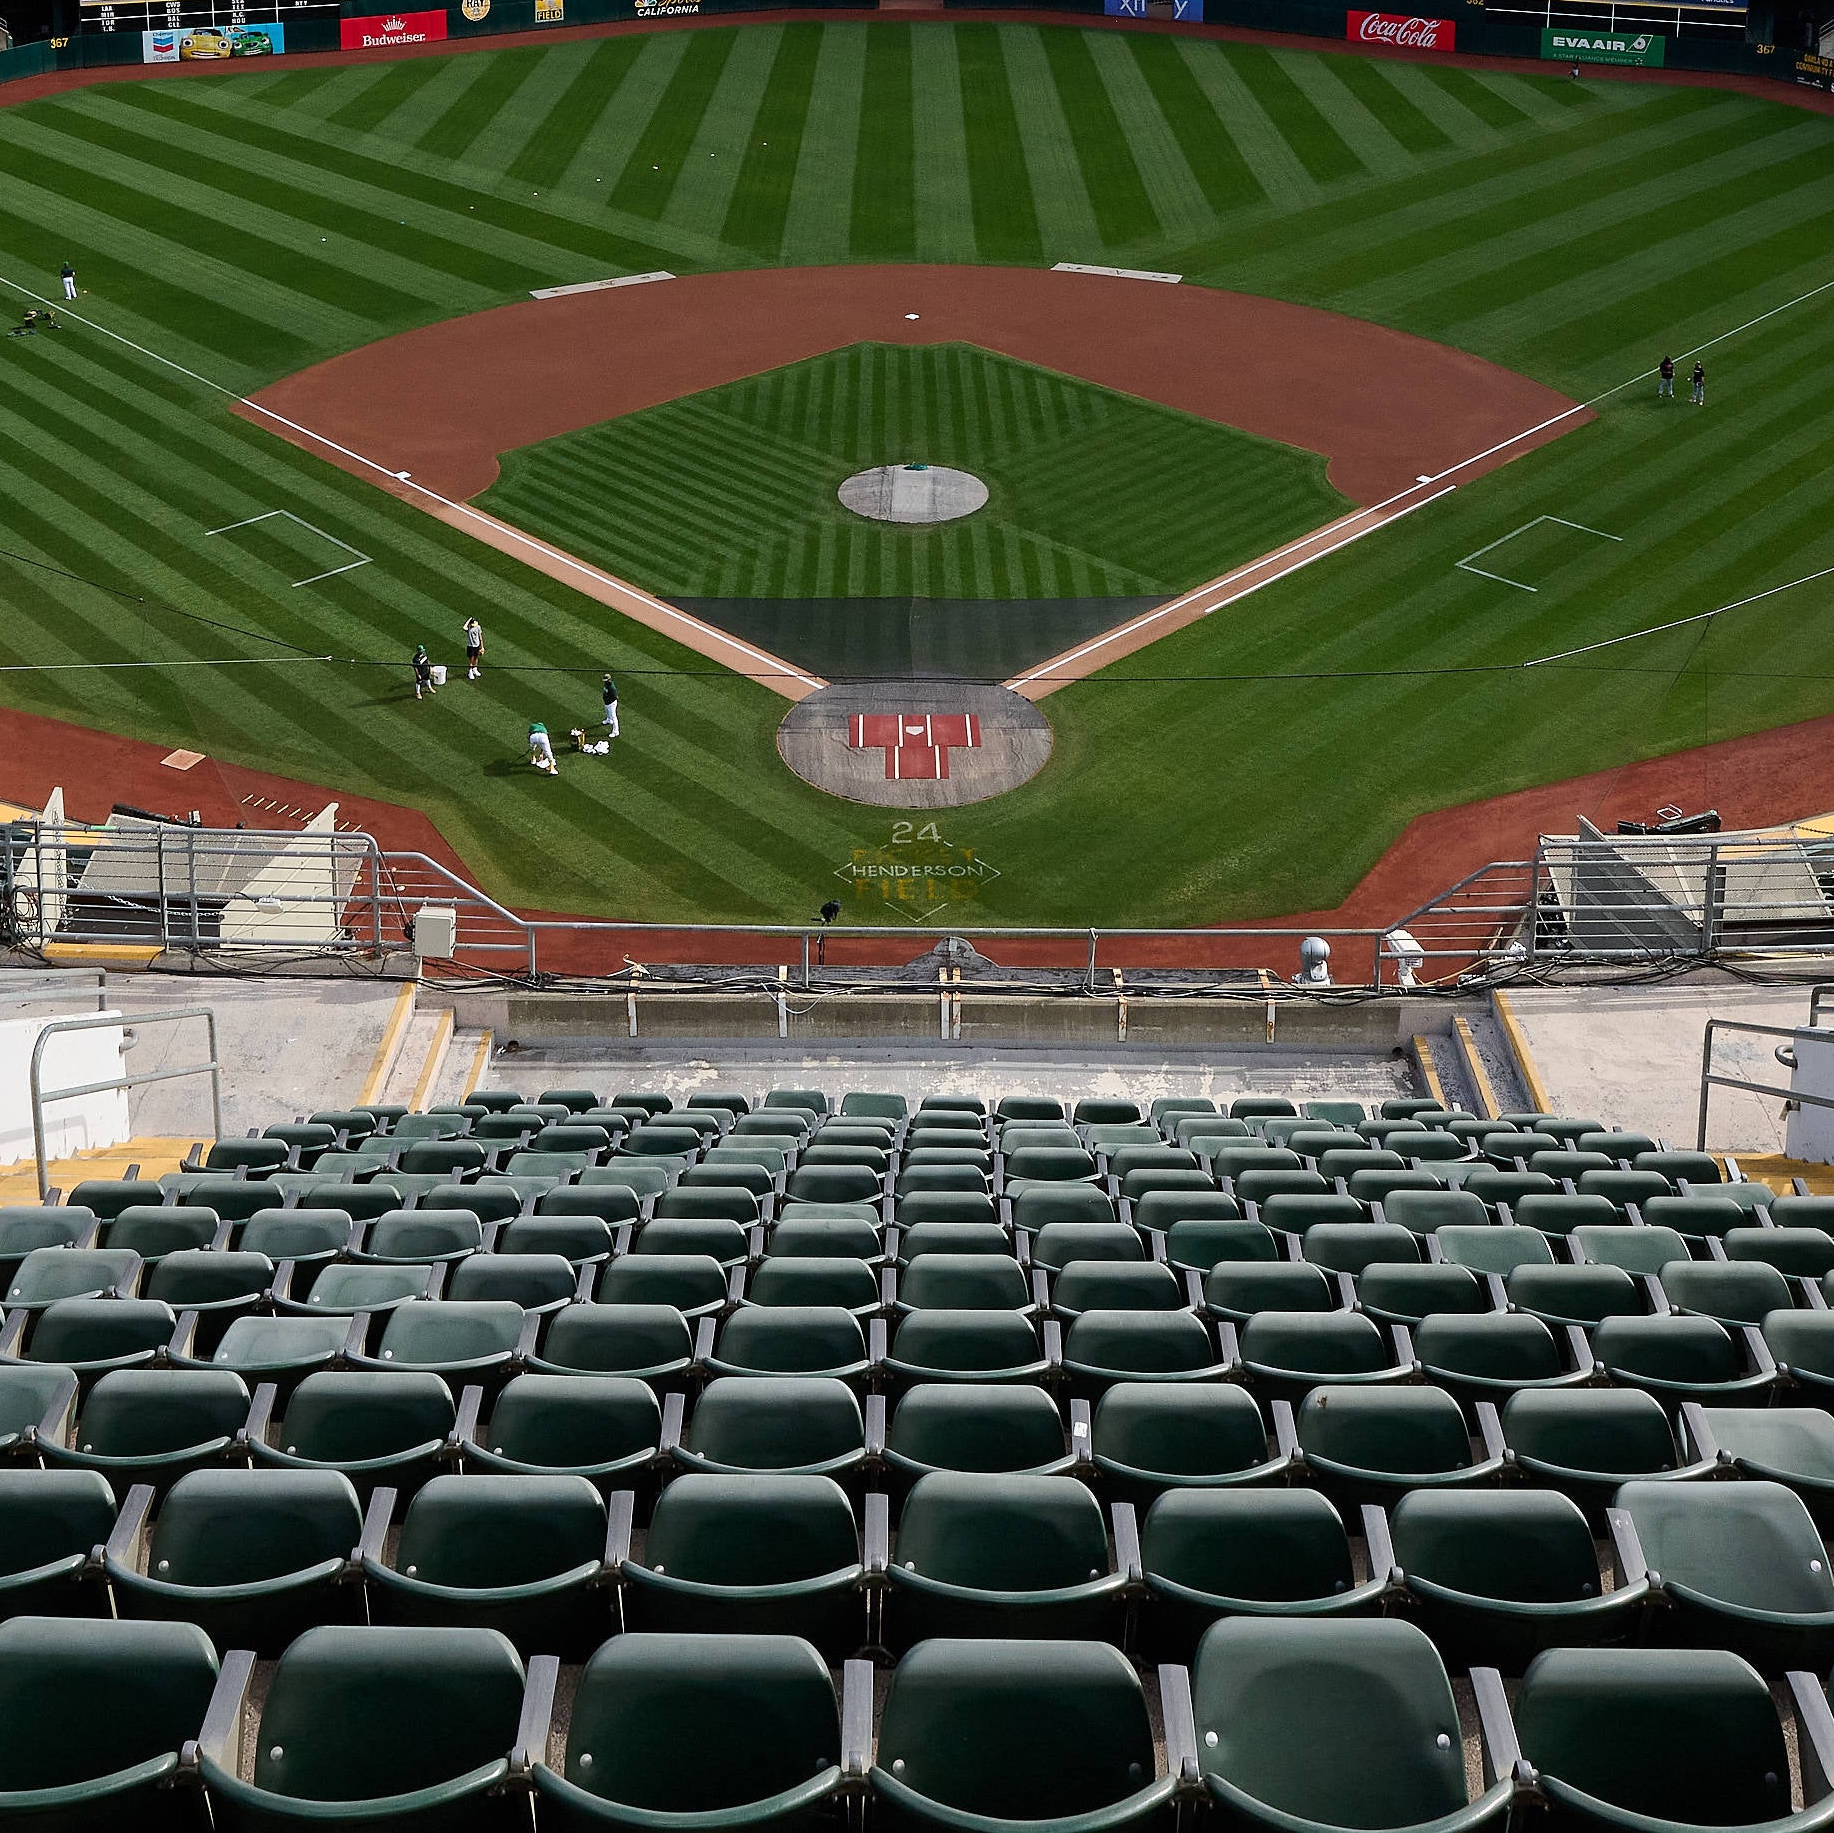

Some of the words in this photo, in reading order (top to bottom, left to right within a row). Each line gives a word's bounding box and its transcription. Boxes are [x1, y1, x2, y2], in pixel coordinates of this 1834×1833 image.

[538, 10, 561, 20] FIELD
[637, 4, 699, 17] CALIFORNIA
[49, 37, 69, 49] 367
[1553, 36, 1591, 49] EVA
[1591, 39, 1626, 52] AIR
[1756, 44, 1776, 55] 367
[891, 820, 942, 845] 24
[850, 863, 984, 878] HENDERSON
[854, 878, 979, 902] FIELD
